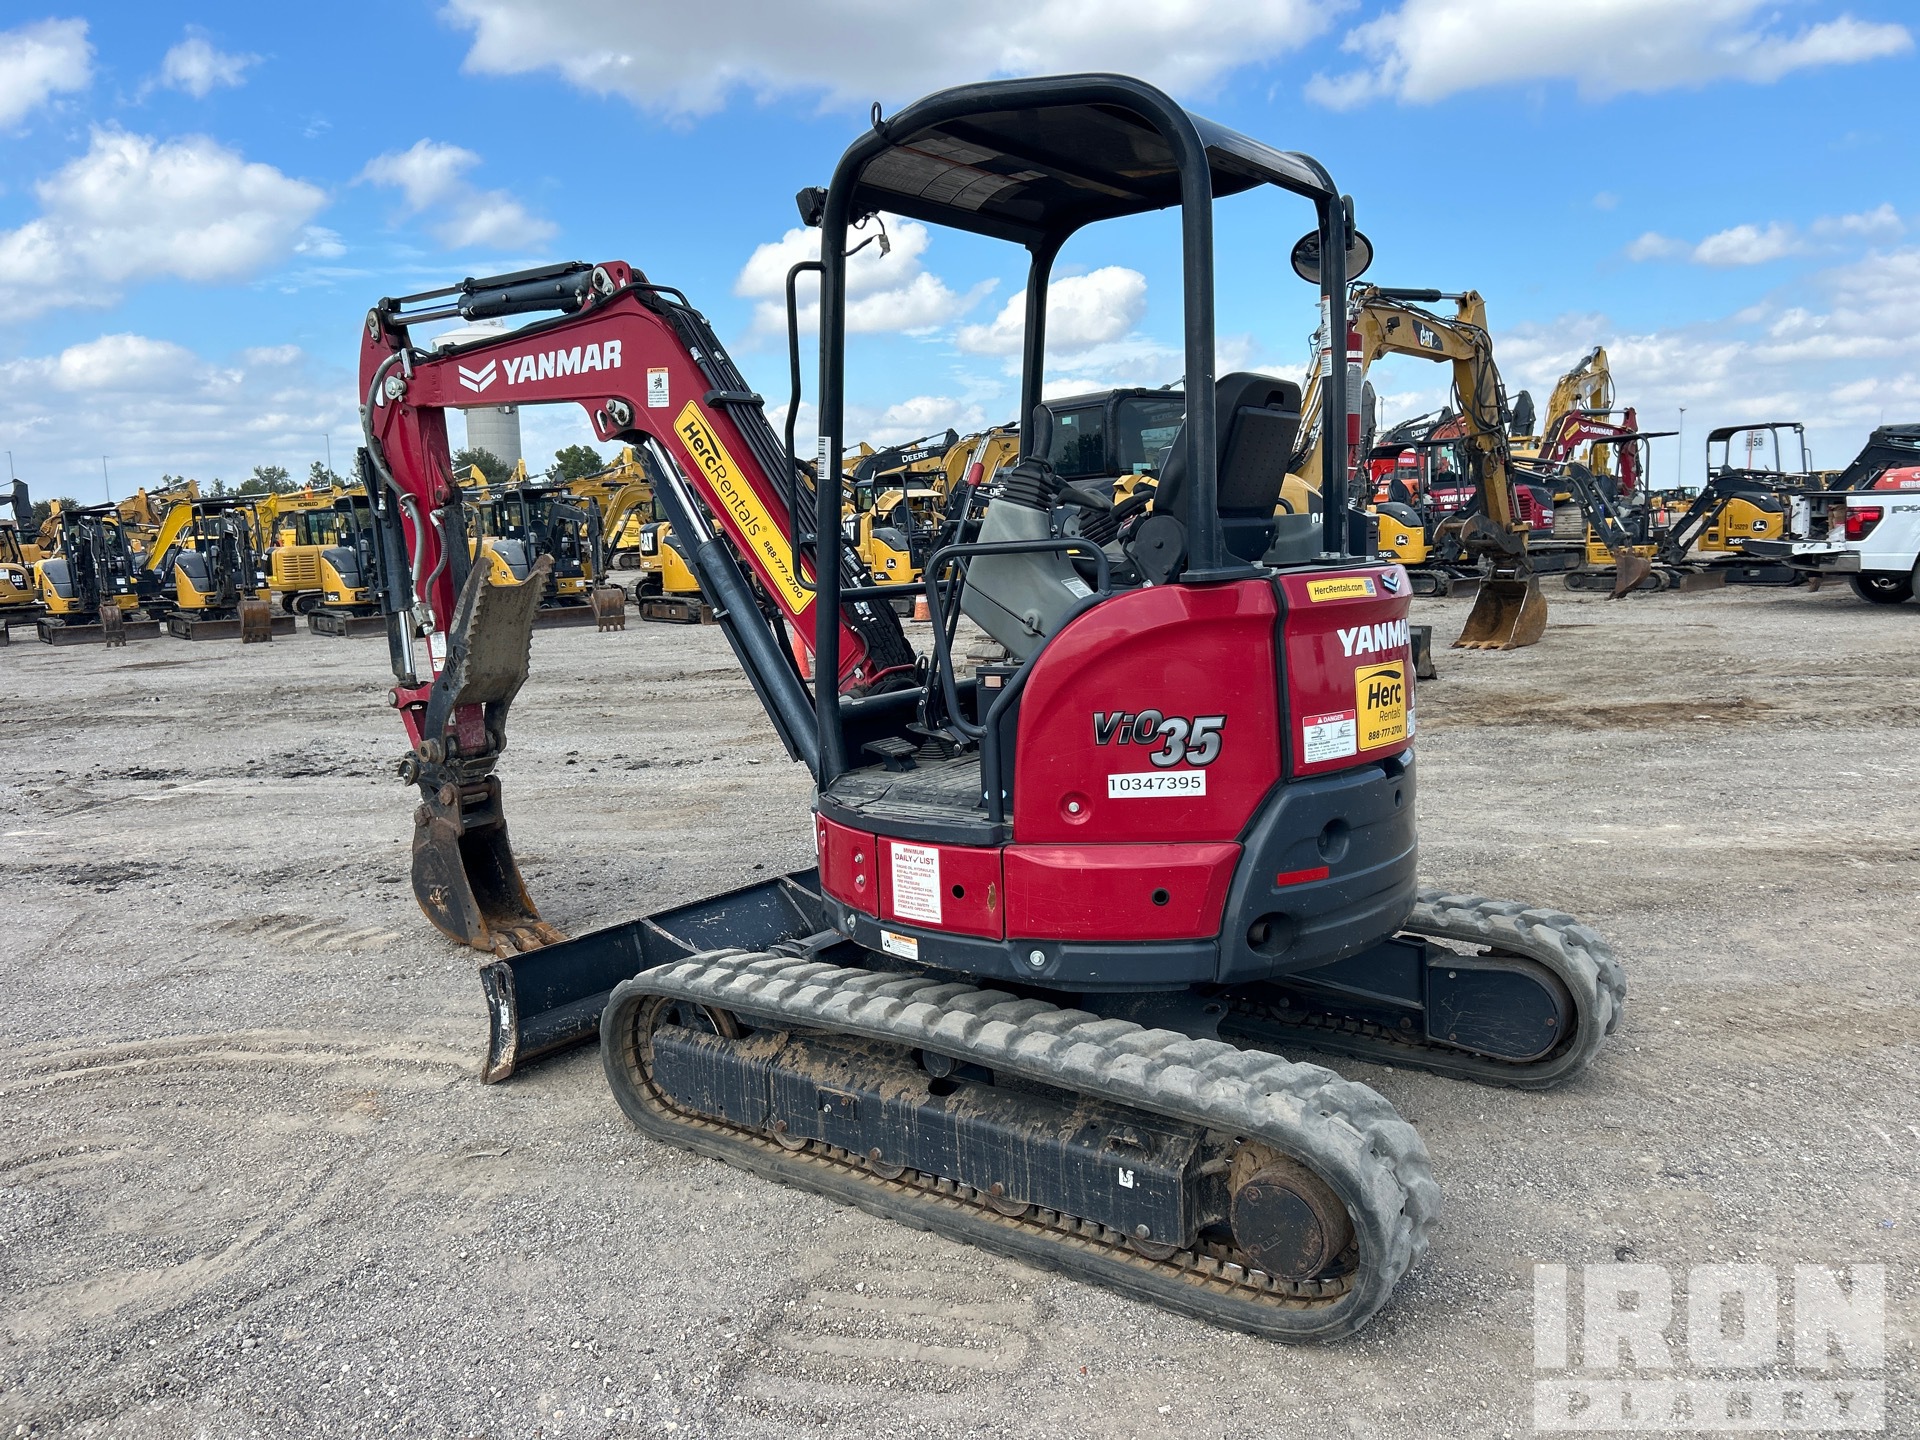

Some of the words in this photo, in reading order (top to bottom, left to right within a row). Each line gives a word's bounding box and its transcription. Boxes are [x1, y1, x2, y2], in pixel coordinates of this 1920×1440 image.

[1419, 323, 1434, 348] CAT
[502, 339, 622, 385] YANMAR
[1589, 426, 1614, 436] YANMAR
[1753, 437, 1763, 447] 58
[901, 450, 929, 463] DEERE
[763, 540, 804, 599] 888-777-2700
[11, 574, 23, 582] CAT
[1314, 583, 1363, 596] HercRentals.com
[1336, 618, 1411, 658] YANMA
[1367, 682, 1402, 710] Herc
[1323, 714, 1344, 723] DANGER
[1379, 709, 1400, 722] Rentals
[1368, 724, 1402, 741] 888-777-2700
[1109, 776, 1201, 791] 10347395
[903, 847, 925, 855] MINIMUM
[895, 853, 913, 863] DAILY
[919, 857, 935, 866] LIST
